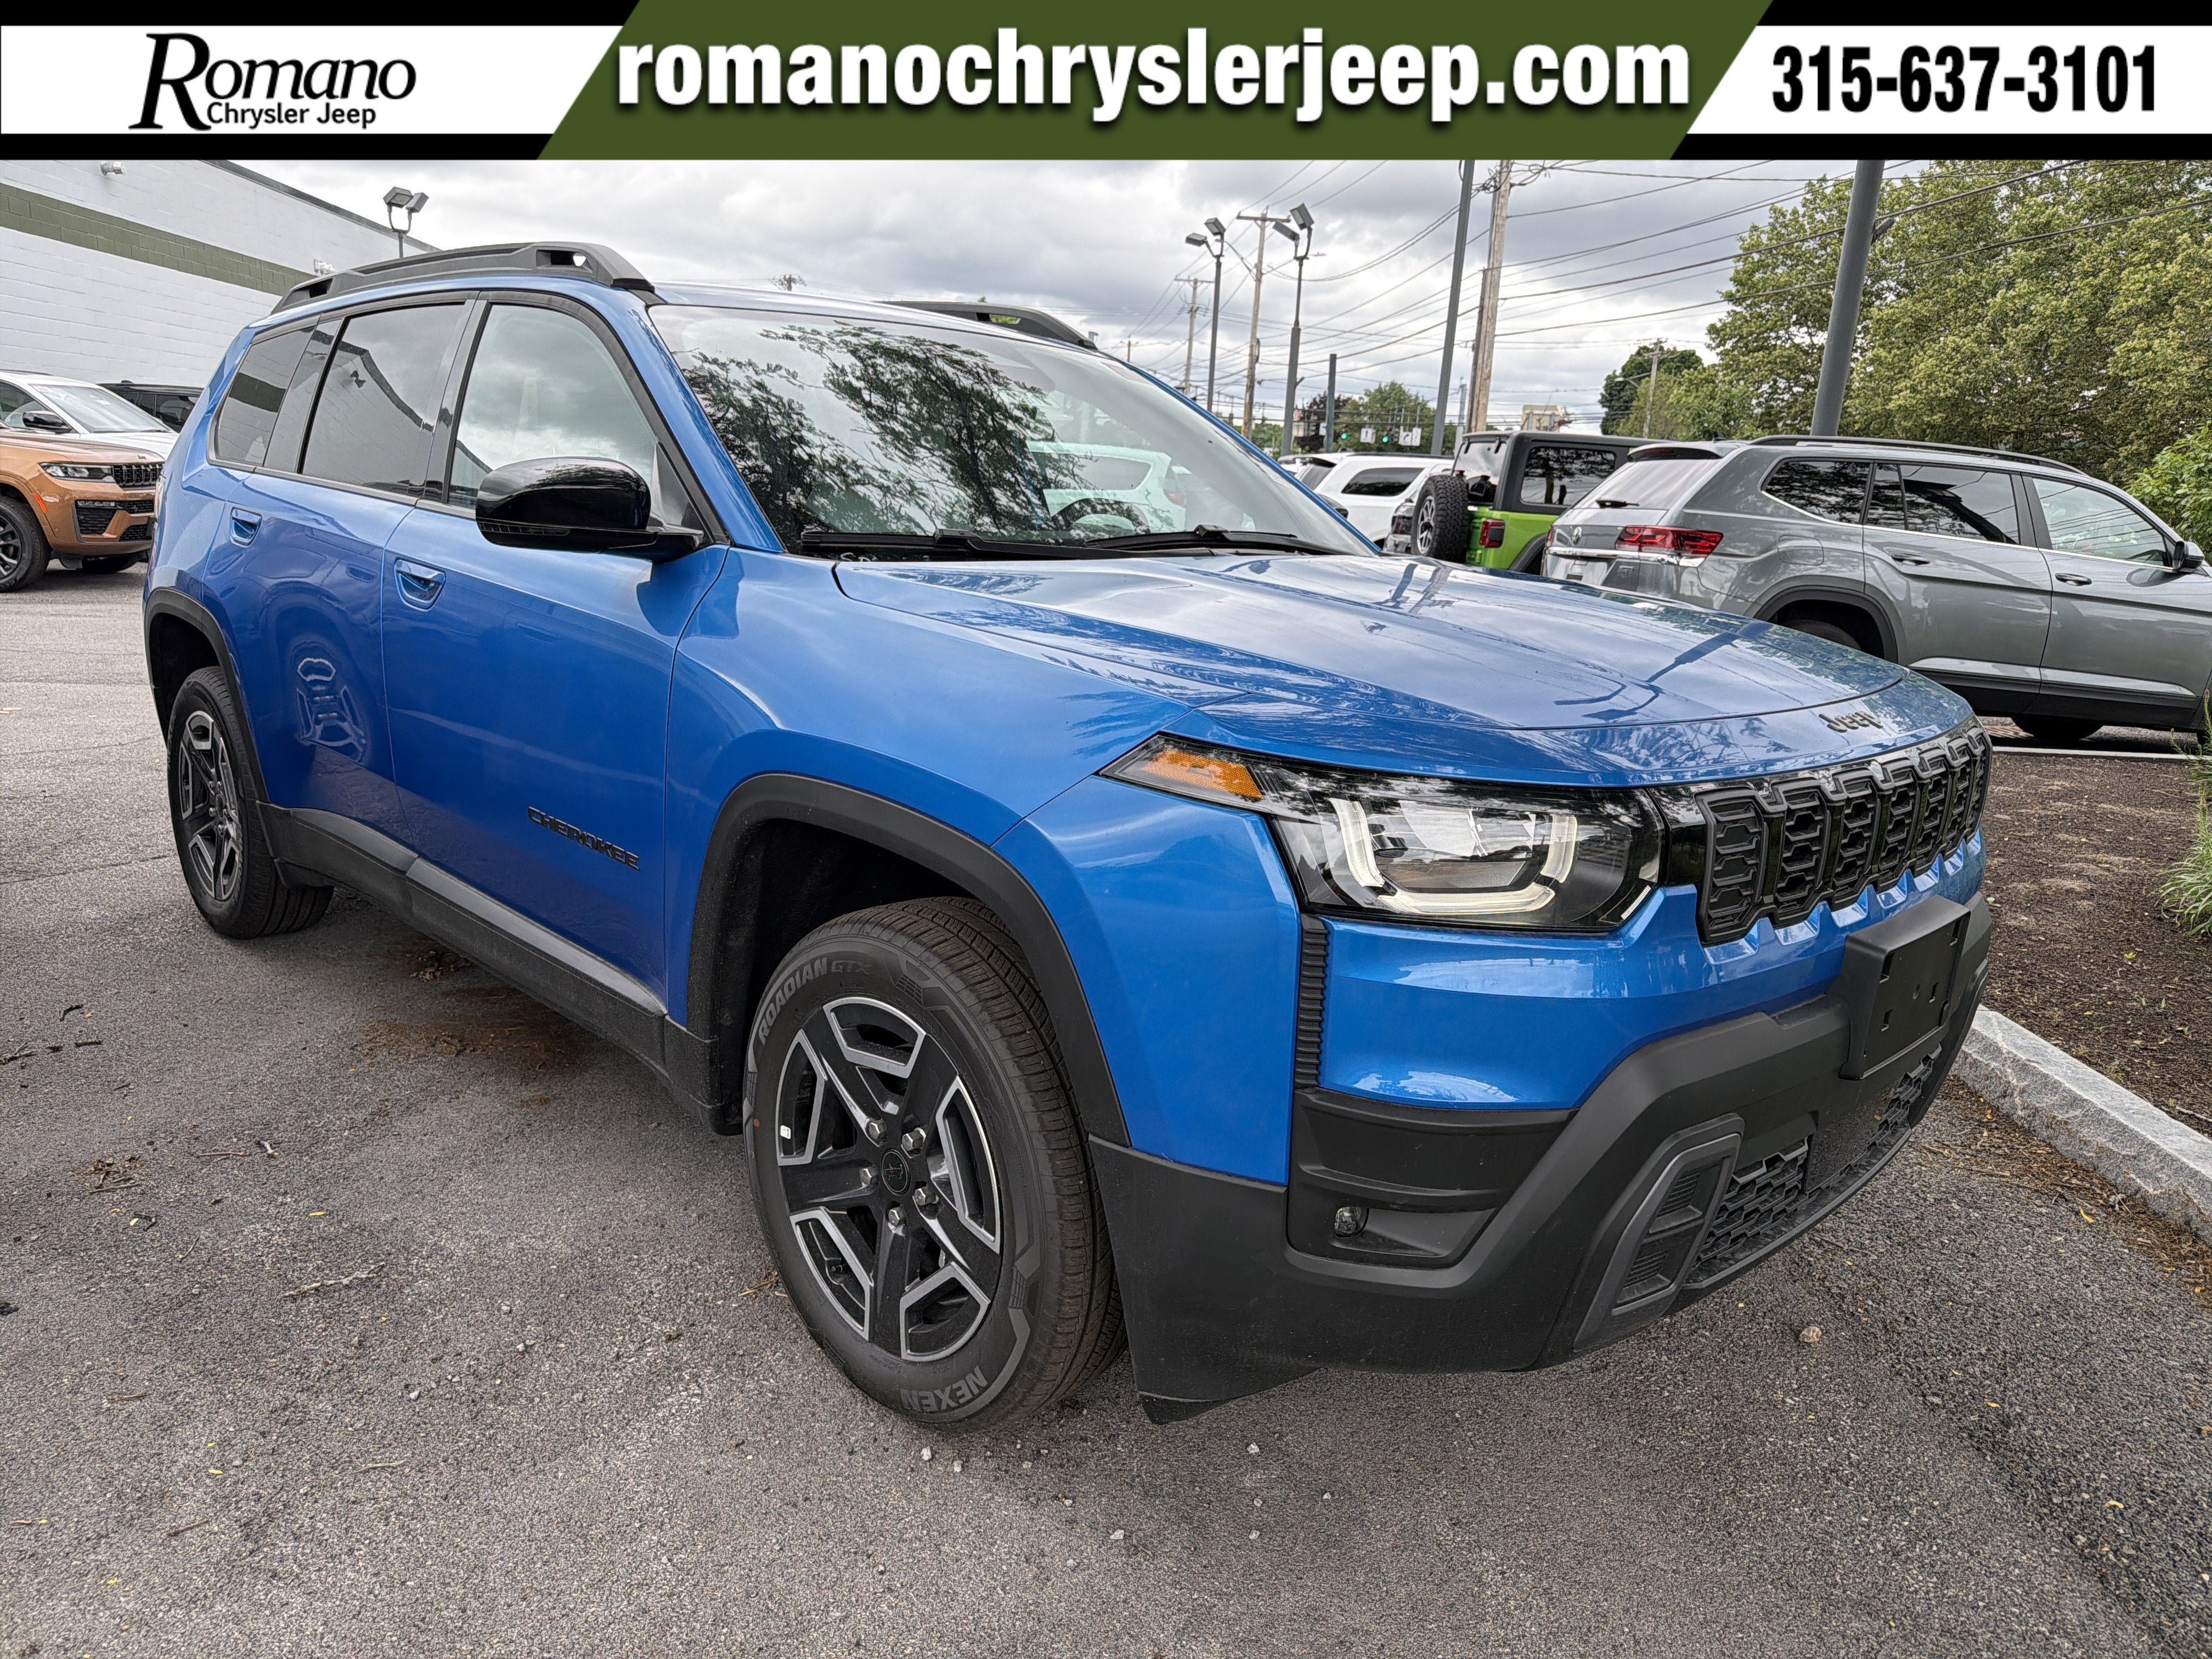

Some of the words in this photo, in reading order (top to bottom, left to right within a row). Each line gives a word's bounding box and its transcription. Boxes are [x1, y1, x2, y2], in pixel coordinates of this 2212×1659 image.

[1818, 710, 1884, 733] Jeep
[527, 806, 640, 872] CHEROKEE
[758, 957, 828, 1046] ROADIAN
[900, 1365, 988, 1412] NEXEN
